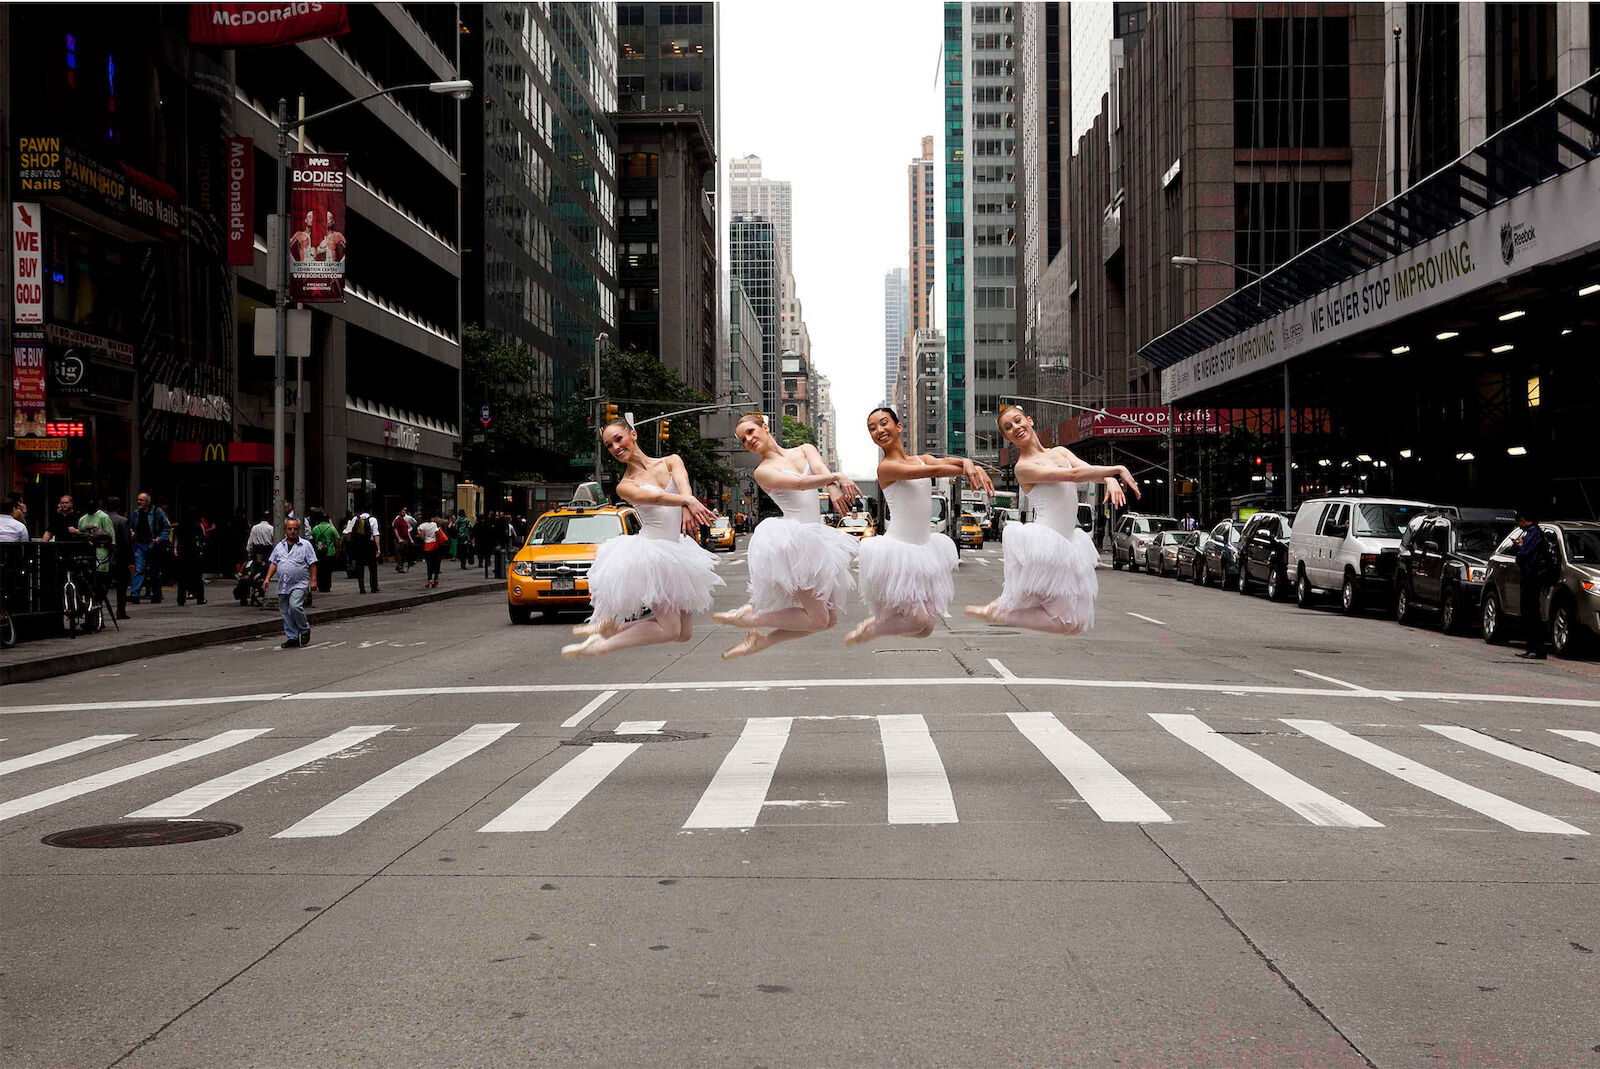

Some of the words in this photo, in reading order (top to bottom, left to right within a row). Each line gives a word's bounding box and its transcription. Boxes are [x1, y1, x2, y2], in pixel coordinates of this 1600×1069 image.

[212, 2, 323, 27] McDonald's
[20, 137, 60, 152] PAWN
[20, 153, 60, 168] SHOP
[308, 158, 330, 166] NYC
[20, 169, 31, 178] WE
[31, 169, 43, 178] BUY
[44, 169, 62, 178] GOLD
[292, 170, 344, 183] BODIES
[21, 179, 62, 190] Nails
[230, 141, 245, 241] McDonald's
[129, 185, 154, 217] Hans
[155, 198, 179, 228] Nails
[15, 231, 39, 251] WE
[1513, 225, 1537, 247] Reebok
[19, 257, 38, 278] BUY
[16, 284, 41, 304] GOLD
[1310, 307, 1324, 335] WE
[1326, 291, 1360, 329] NEVER
[1362, 277, 1391, 315] STOP
[1394, 240, 1476, 302] IMPROVING.
[14, 347, 27, 367] WE
[28, 347, 43, 367] BUY
[1193, 363, 1201, 381] WE
[1202, 355, 1220, 380] NEVER
[1220, 348, 1236, 373] STOP
[1236, 332, 1277, 367] IMPROVING.
[152, 381, 232, 425] McDonald's
[1178, 408, 1211, 421] café
[45, 422, 84, 437] ASH
